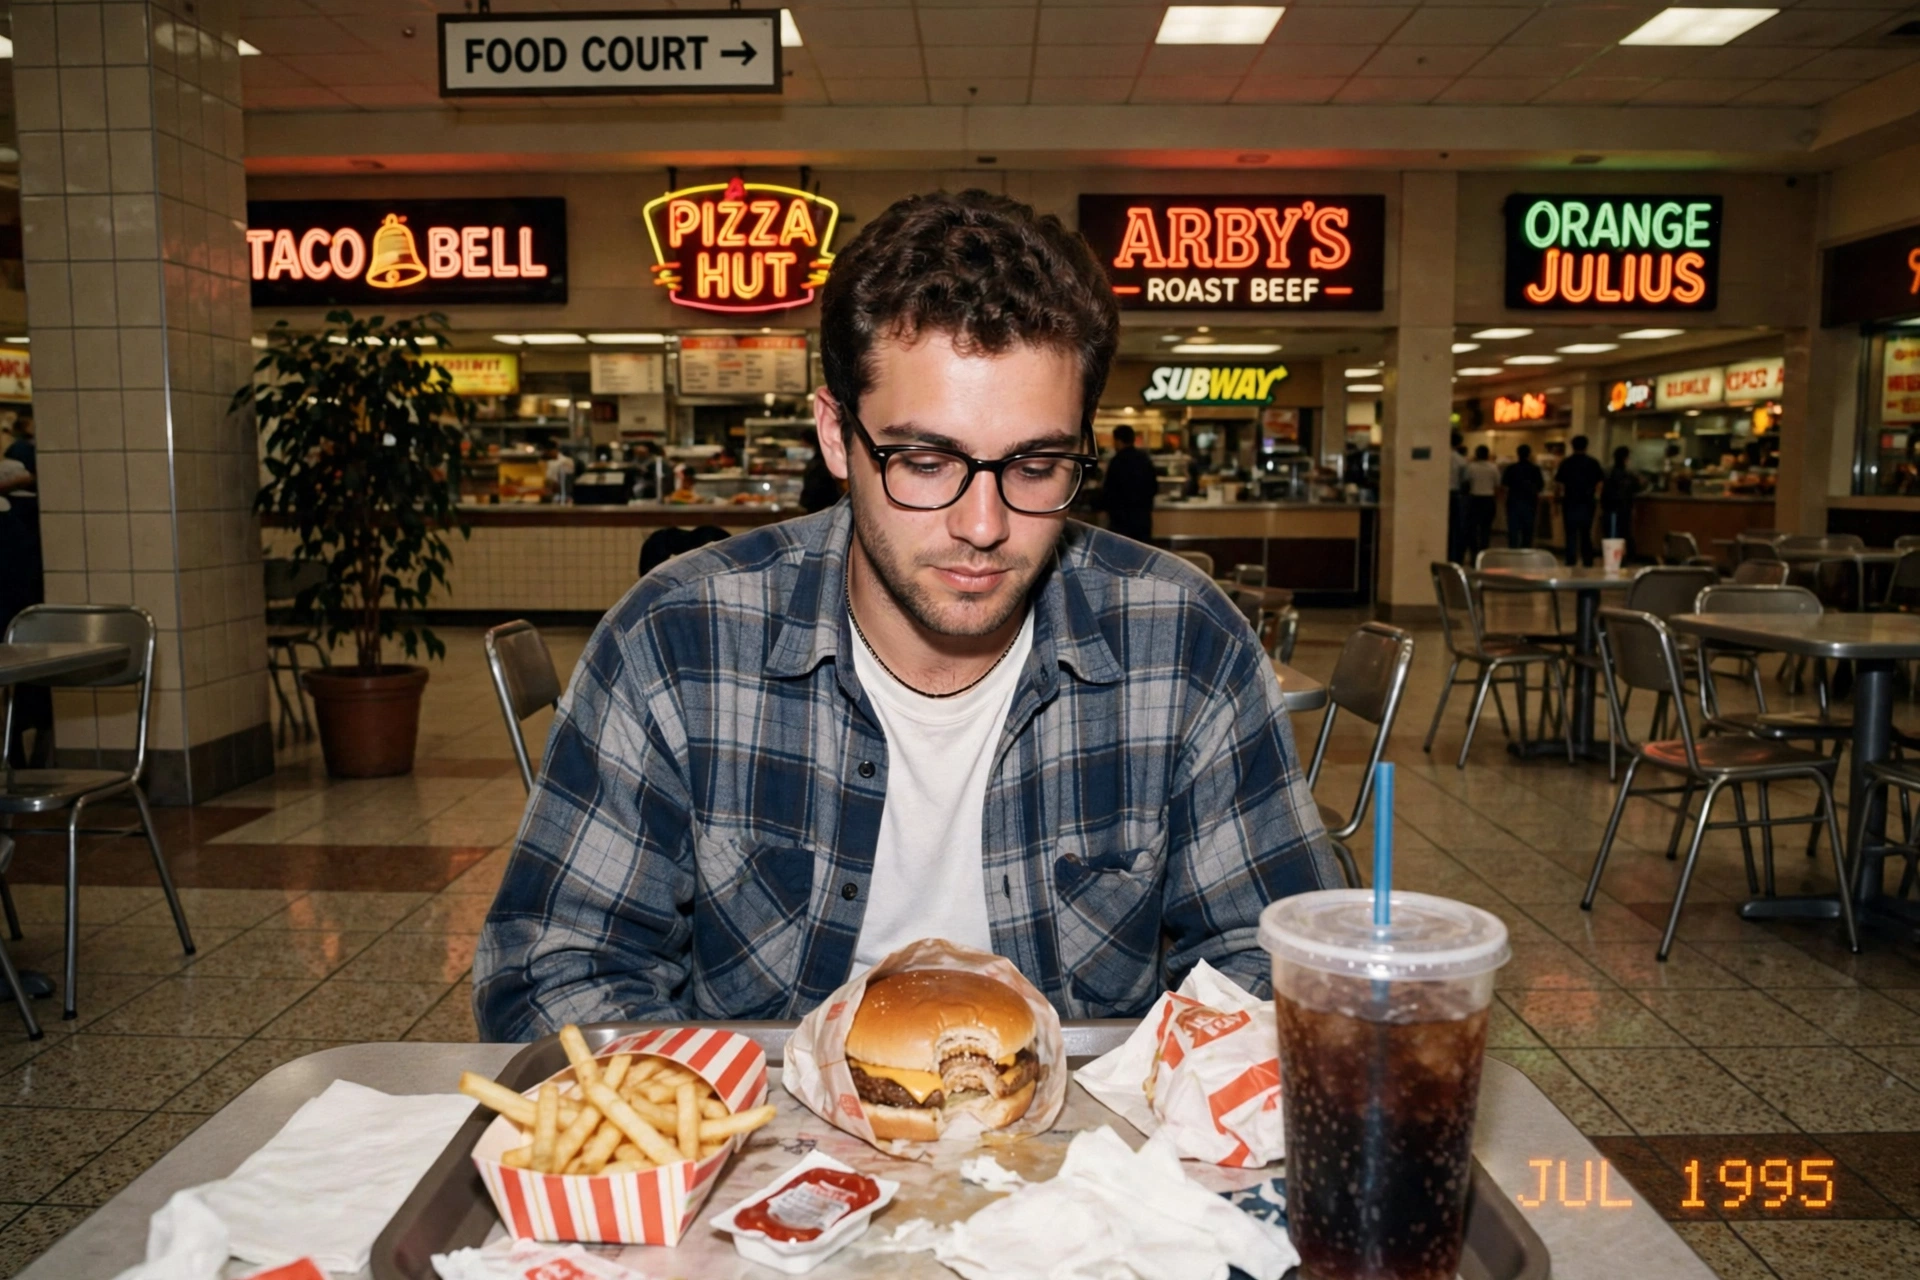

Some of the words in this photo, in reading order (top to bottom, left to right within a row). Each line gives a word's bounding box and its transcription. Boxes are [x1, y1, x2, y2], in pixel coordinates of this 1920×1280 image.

[465, 37, 568, 74] FOOD
[581, 36, 708, 72] COURT
[668, 200, 817, 248] PIZZA
[1115, 201, 1352, 270] ARBY'S
[1524, 199, 1712, 249] ORANGE
[247, 229, 366, 281] TACO
[428, 227, 548, 279] BELL
[696, 252, 795, 299] HUT
[1525, 250, 1707, 303] JULIUS
[1147, 277, 1237, 305] ROAST
[1250, 275, 1320, 304] BEEF
[1144, 365, 1288, 401] SUBWAY
